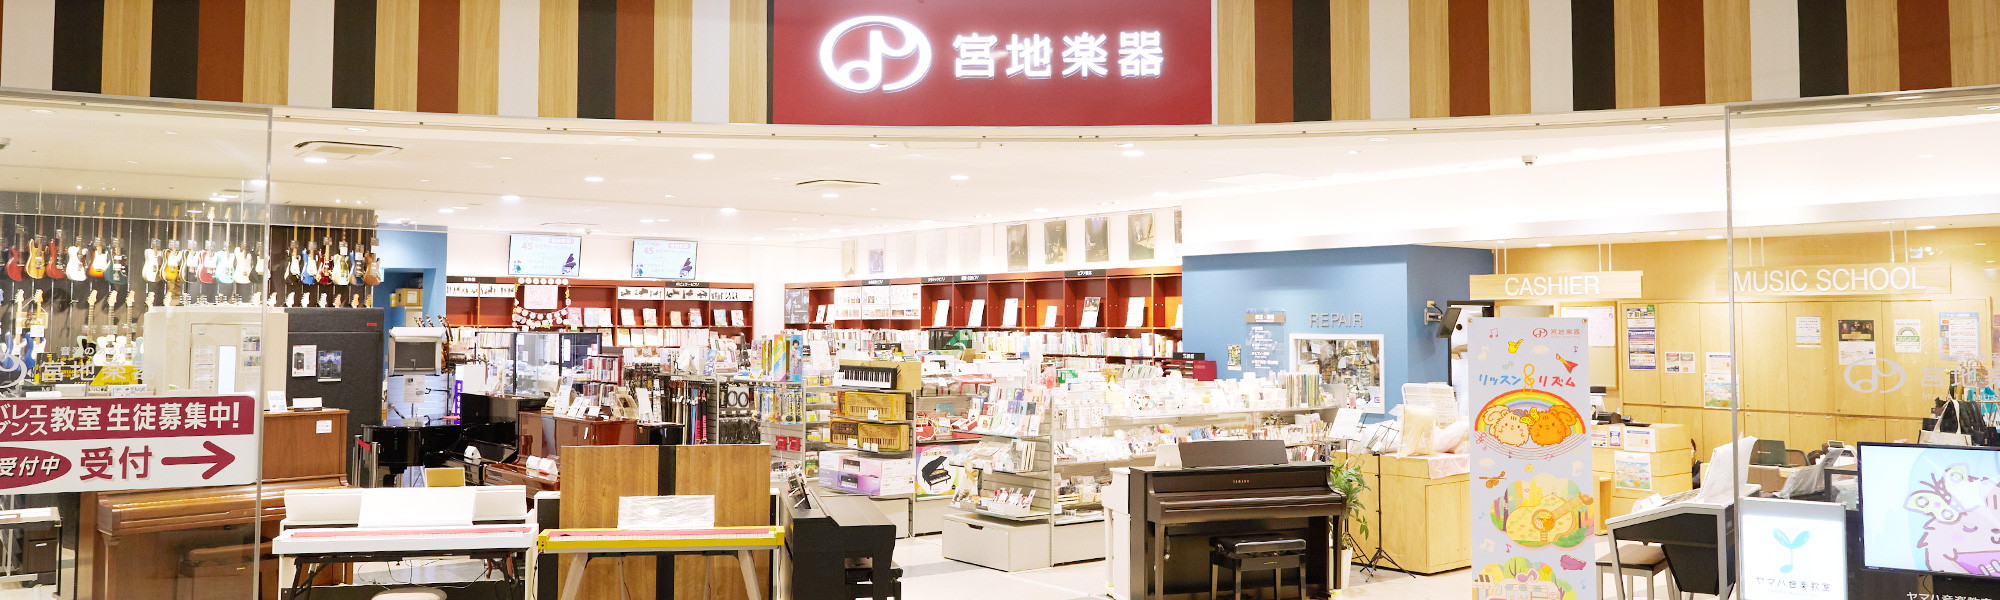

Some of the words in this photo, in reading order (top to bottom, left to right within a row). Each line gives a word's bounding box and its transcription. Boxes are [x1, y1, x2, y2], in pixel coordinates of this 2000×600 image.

[952, 32, 1163, 79] 宮地楽器
[1504, 275, 1600, 297] CASHIER
[1733, 269, 1807, 293] MUSIC
[1816, 266, 1926, 292] SCHOOL
[1310, 313, 1363, 328] REPAIR
[1479, 374, 1522, 386] リッスン
[1539, 375, 1576, 387] リズム
[50, 405, 101, 432] 教室
[107, 401, 239, 431] 生徒募集中!
[0, 456, 60, 477] 受付中
[80, 445, 153, 481] 受付
[1756, 576, 1831, 592] ヤマハ音楽教室
